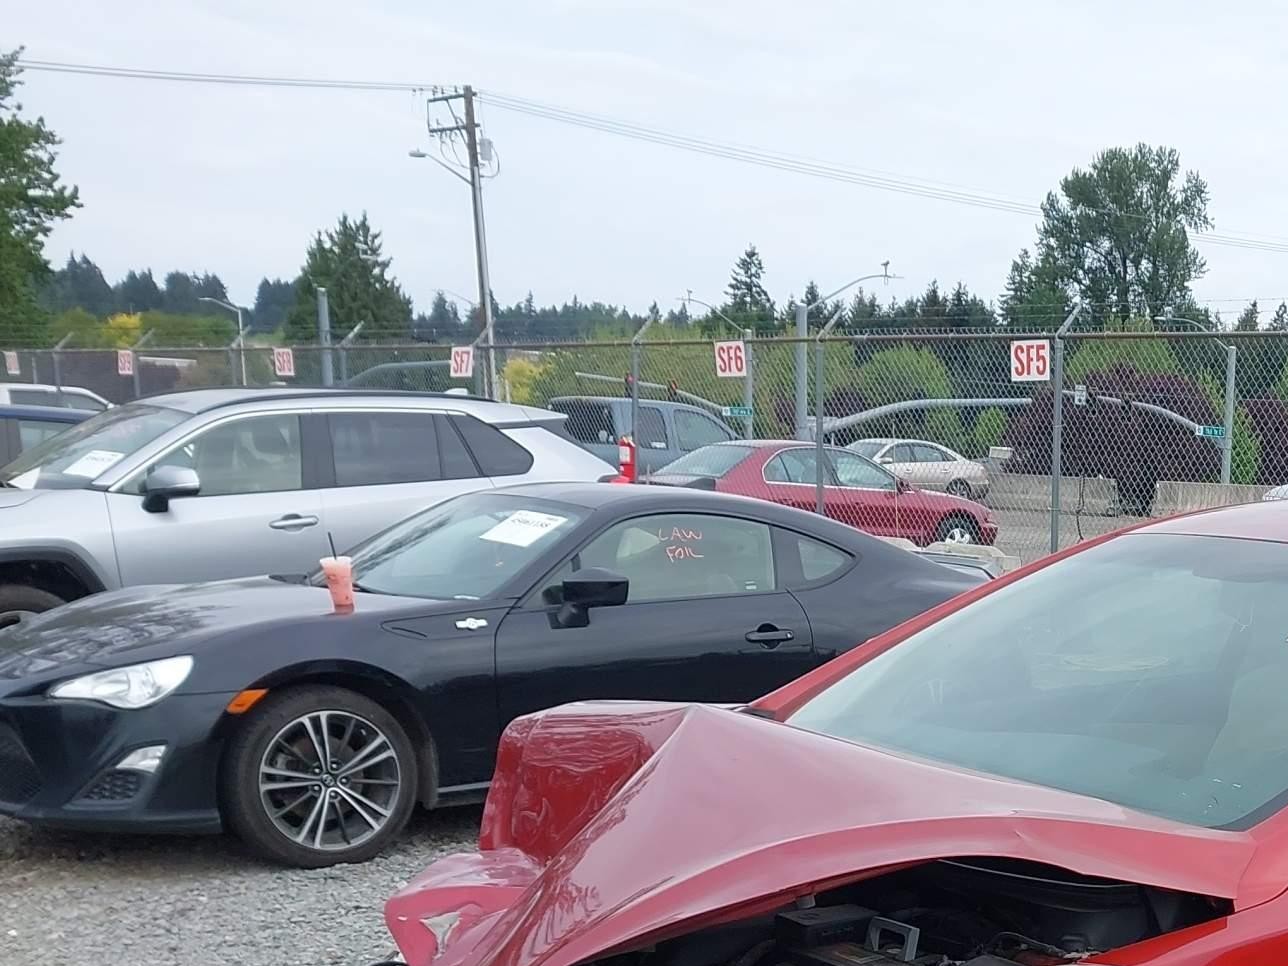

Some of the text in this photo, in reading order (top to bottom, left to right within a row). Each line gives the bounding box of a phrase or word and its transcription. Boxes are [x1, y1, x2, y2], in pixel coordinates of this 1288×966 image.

[276, 351, 292, 373] SF8
[453, 350, 471, 374] SF7
[718, 345, 743, 373] SF6
[1014, 344, 1047, 376] SF5
